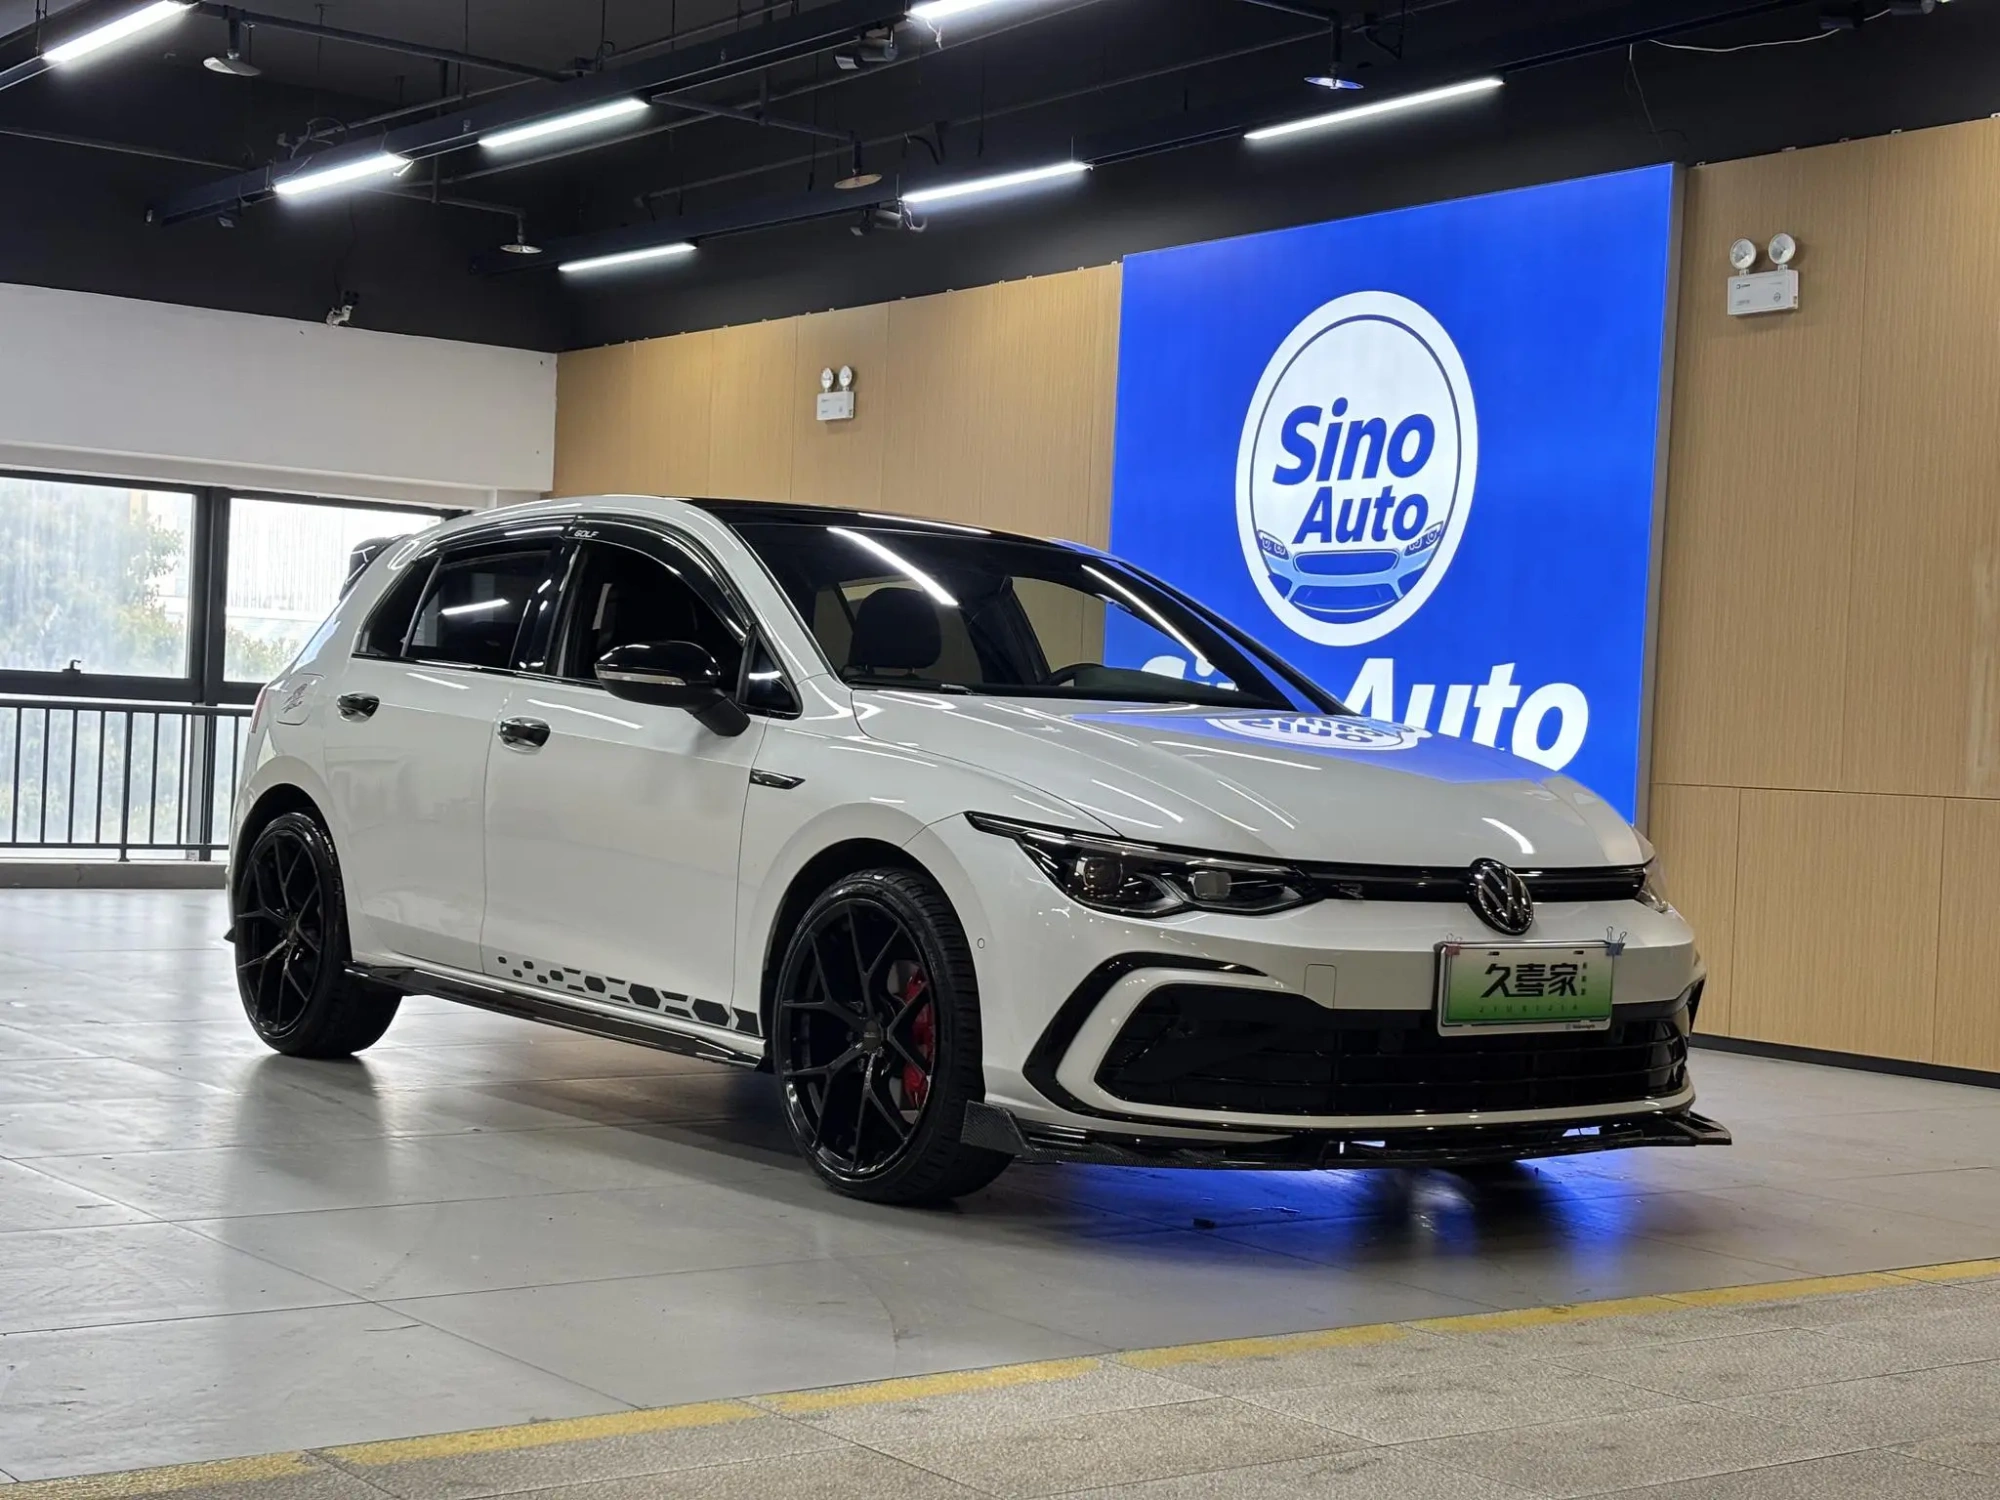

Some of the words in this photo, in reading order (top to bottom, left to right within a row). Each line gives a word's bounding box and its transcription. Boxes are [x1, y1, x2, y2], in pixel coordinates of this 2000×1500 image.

[1272, 397, 1435, 486] Sino
[574, 529, 600, 538] GOLF
[1291, 485, 1429, 544] Auto
[1343, 658, 1589, 771] Auto
[1480, 962, 1578, 999] 久喜家
